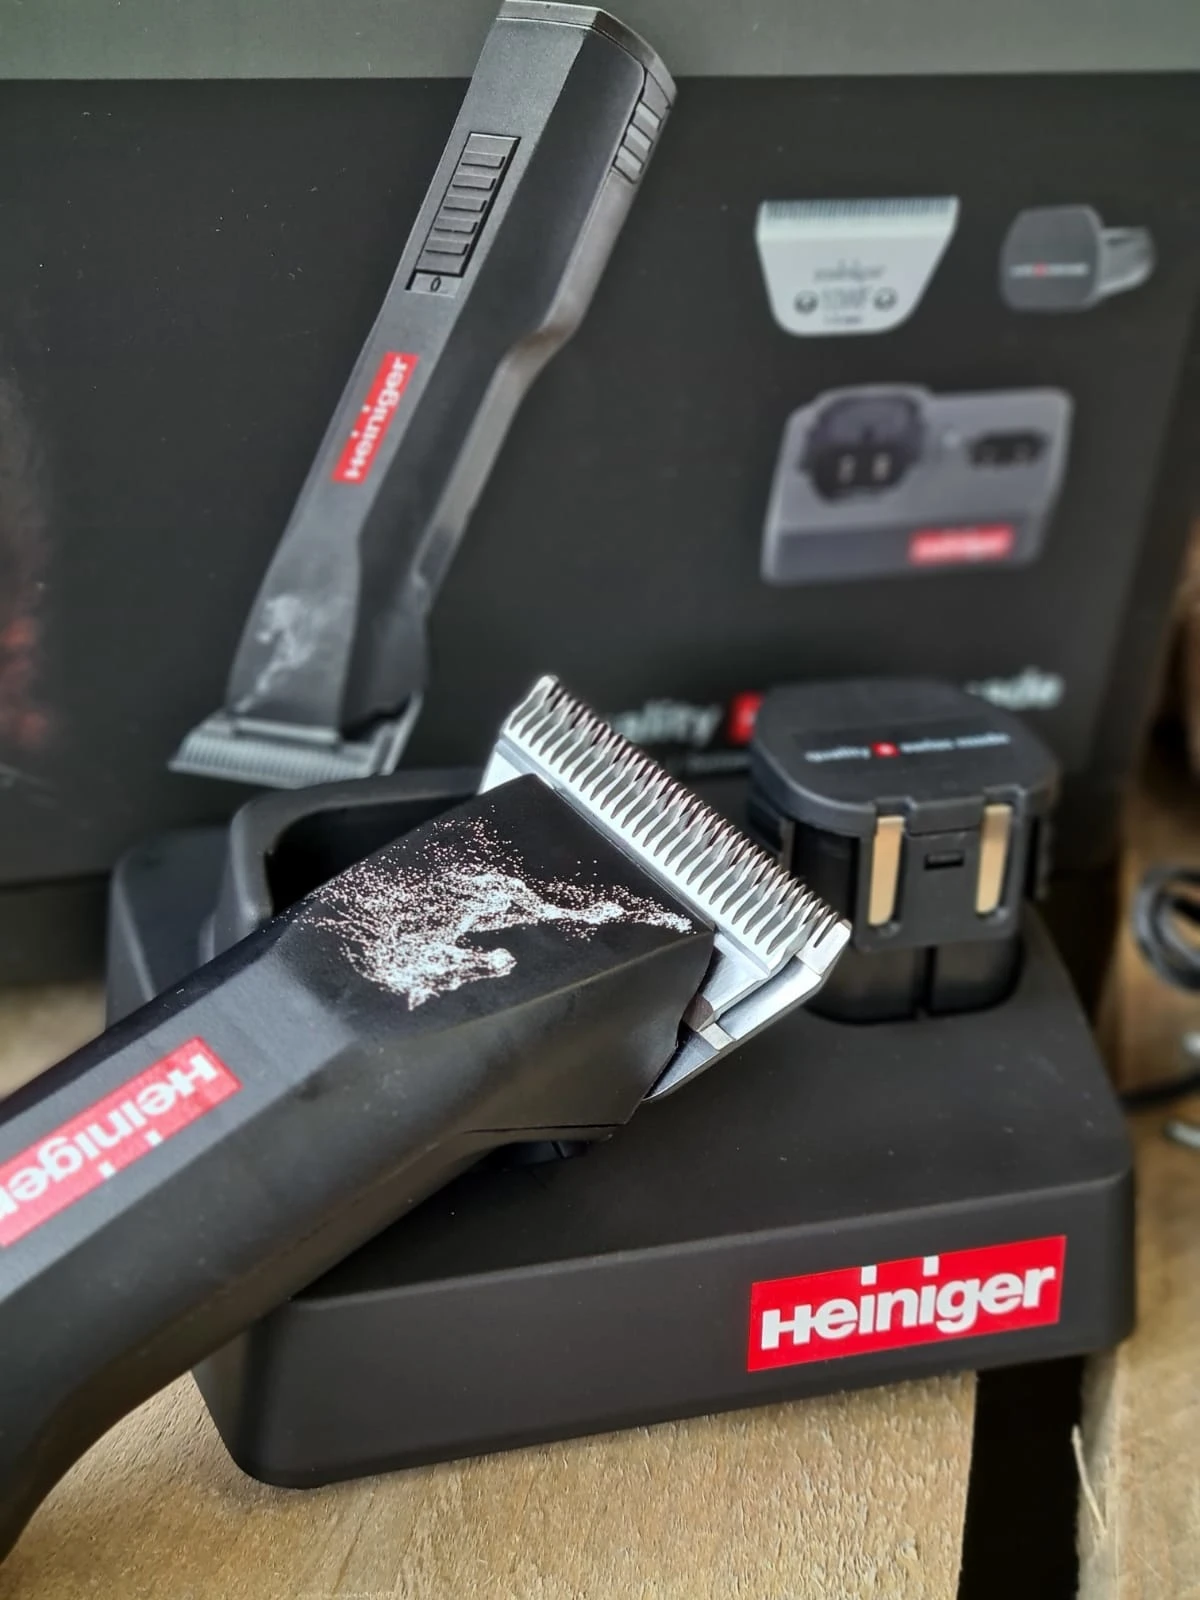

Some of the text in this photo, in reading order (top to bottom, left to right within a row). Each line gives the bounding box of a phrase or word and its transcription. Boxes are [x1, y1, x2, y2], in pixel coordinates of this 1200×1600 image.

[343, 356, 408, 479] Heiniger
[804, 732, 1010, 763] quality swiss made
[760, 1255, 1056, 1350] Heiniger
